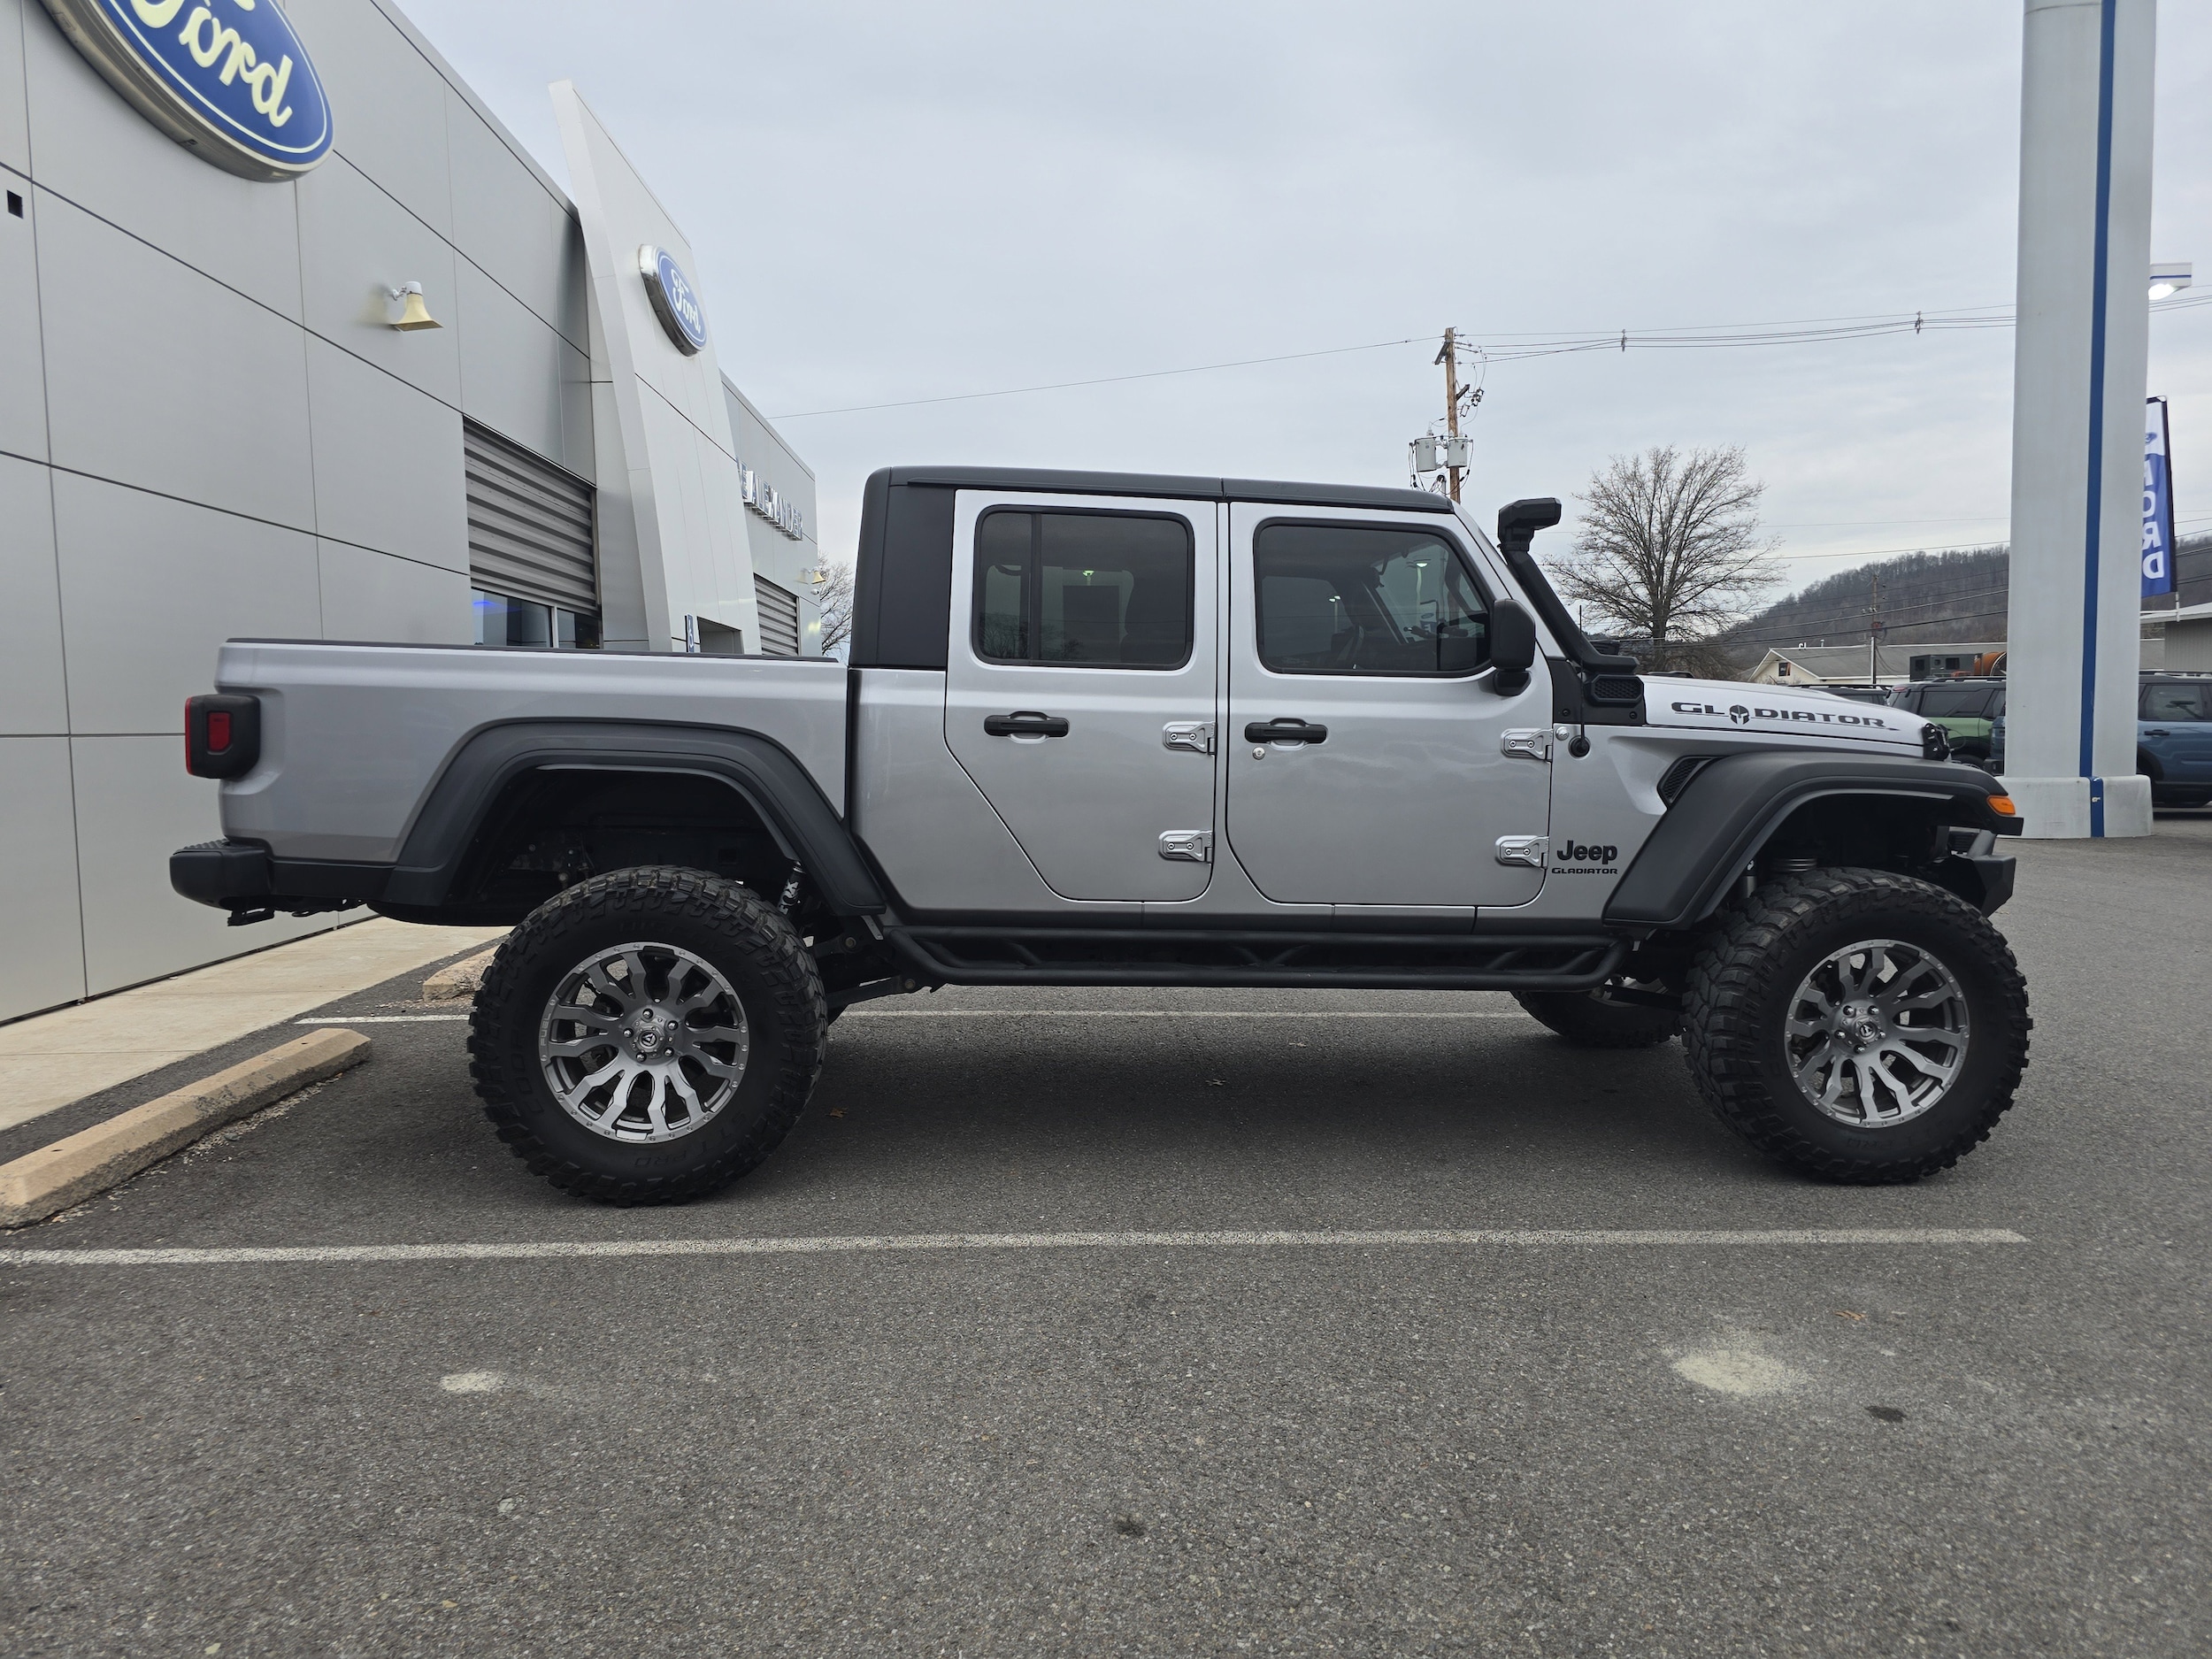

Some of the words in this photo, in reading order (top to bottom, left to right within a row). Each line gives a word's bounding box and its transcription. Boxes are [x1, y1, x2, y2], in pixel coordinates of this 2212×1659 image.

[671, 268, 701, 334] Ford
[1556, 840, 1617, 864] Jeep
[540, 1013, 551, 1046] FUEL
